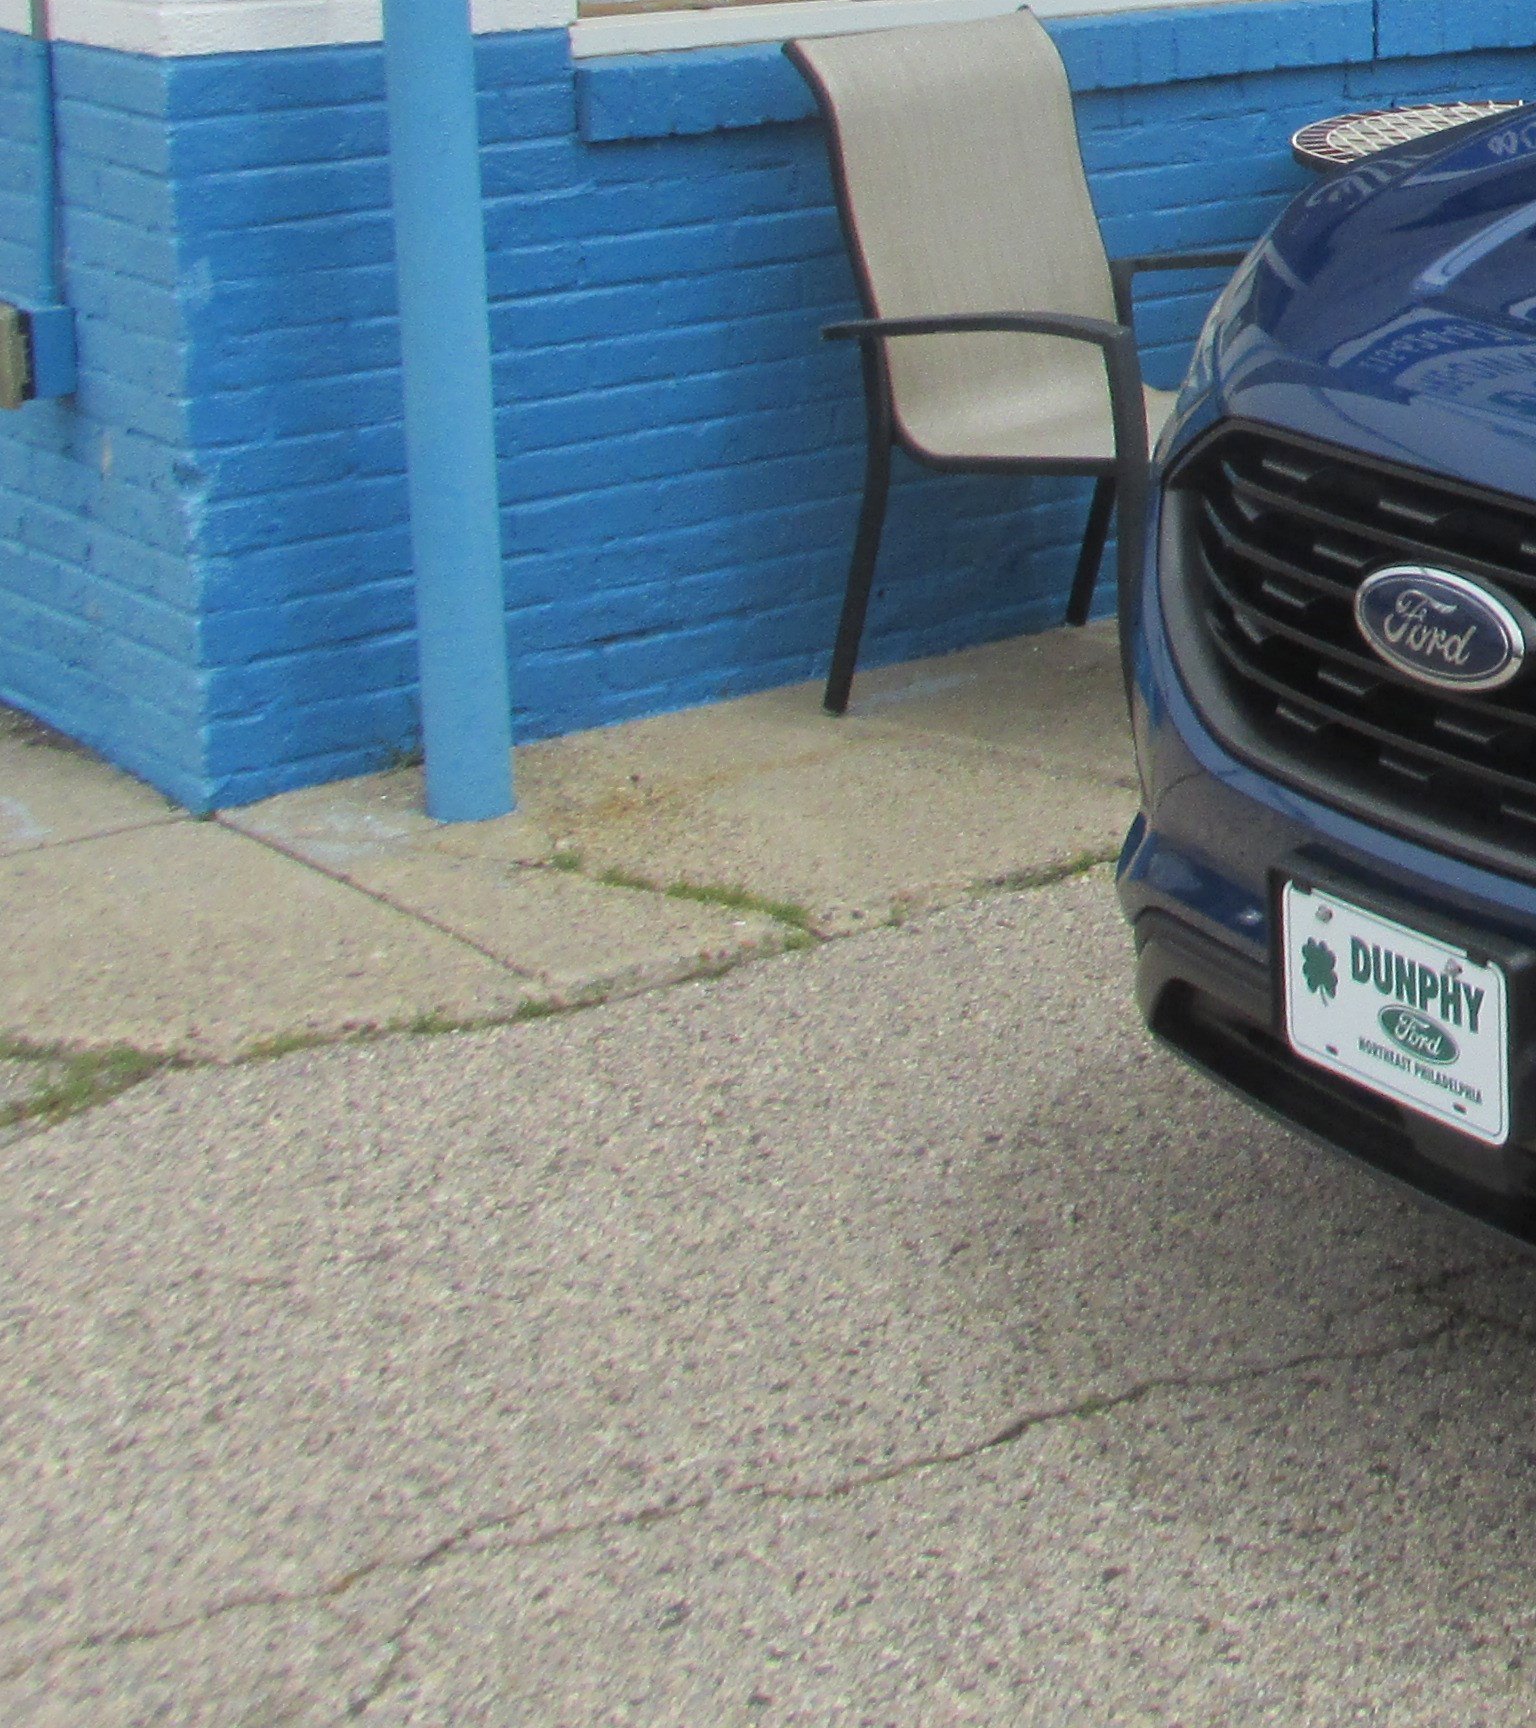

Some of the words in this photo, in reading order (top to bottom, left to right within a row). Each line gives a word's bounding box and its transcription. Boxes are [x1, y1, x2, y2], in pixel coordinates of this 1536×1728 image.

[1383, 588, 1478, 666] Ford
[1350, 935, 1485, 1035] DUNPHY
[1393, 1012, 1443, 1057] Ford
